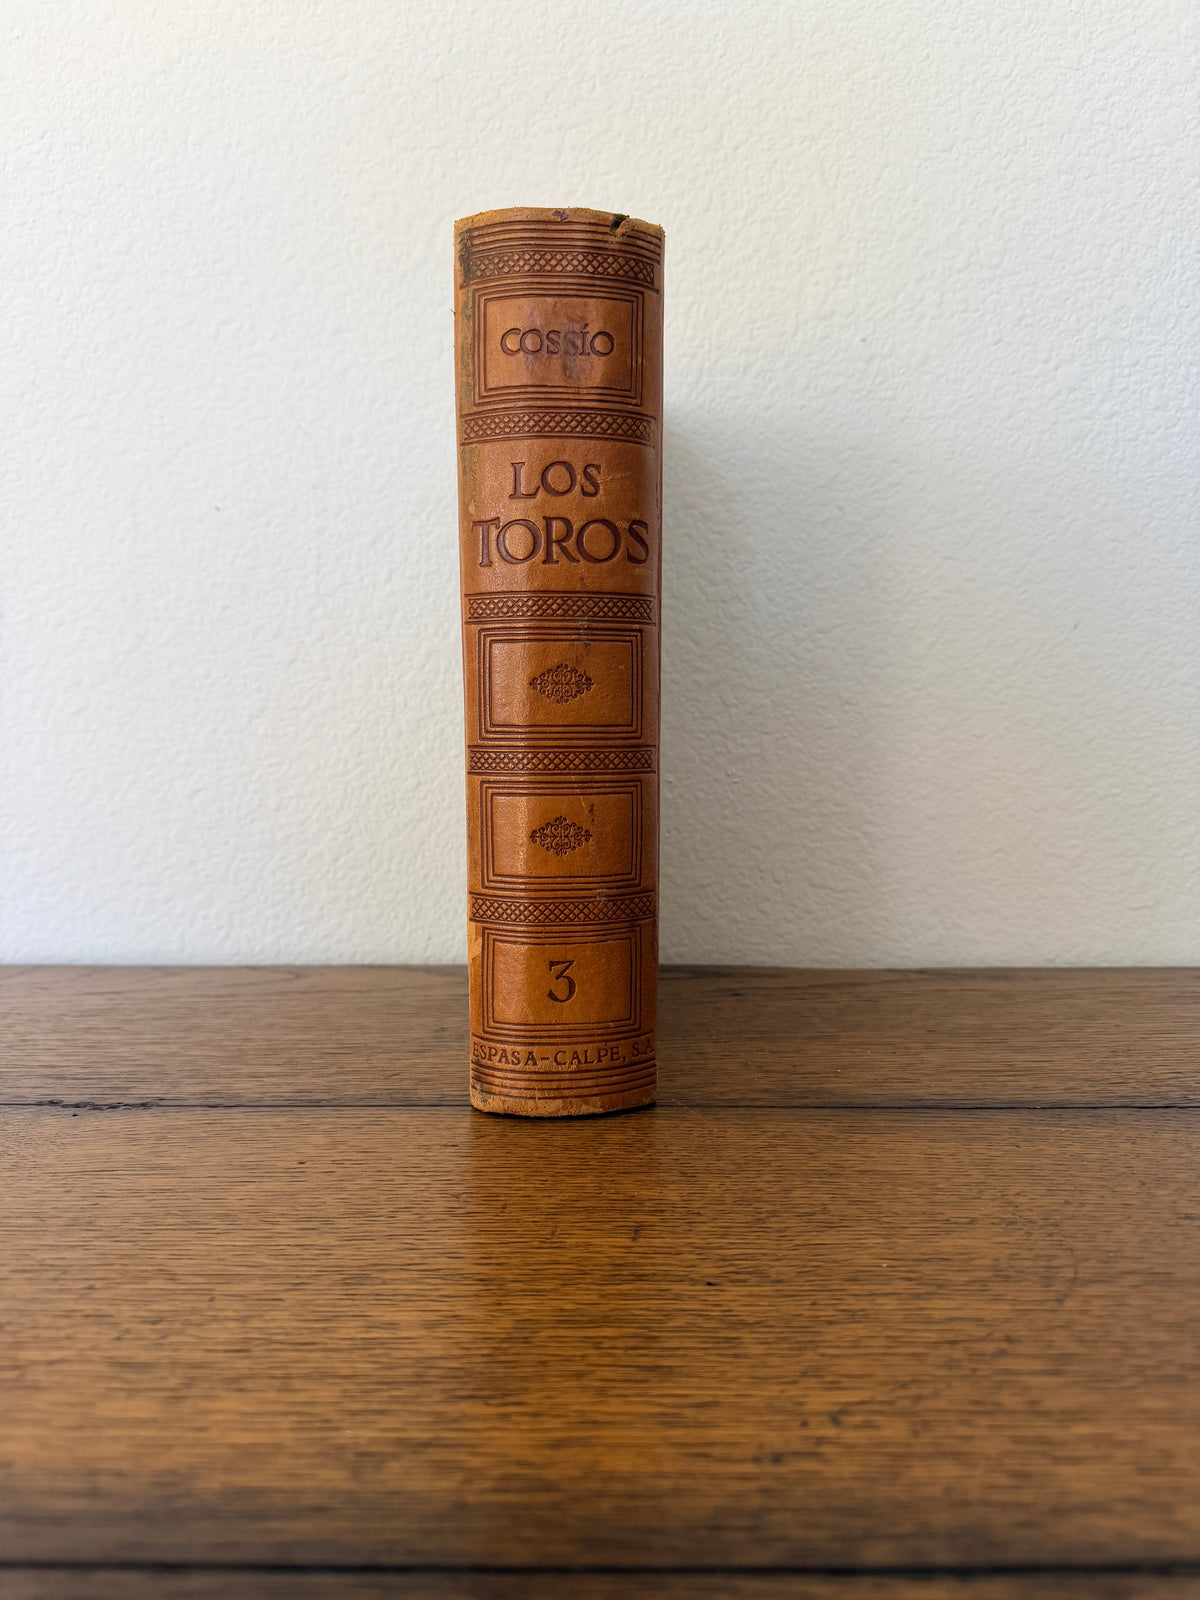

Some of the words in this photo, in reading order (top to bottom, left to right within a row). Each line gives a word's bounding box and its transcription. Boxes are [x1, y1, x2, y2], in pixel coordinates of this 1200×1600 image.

[501, 323, 614, 356] COSSÍO
[509, 461, 601, 499] LOS
[471, 516, 649, 567] TOROS
[547, 960, 577, 1004] 3
